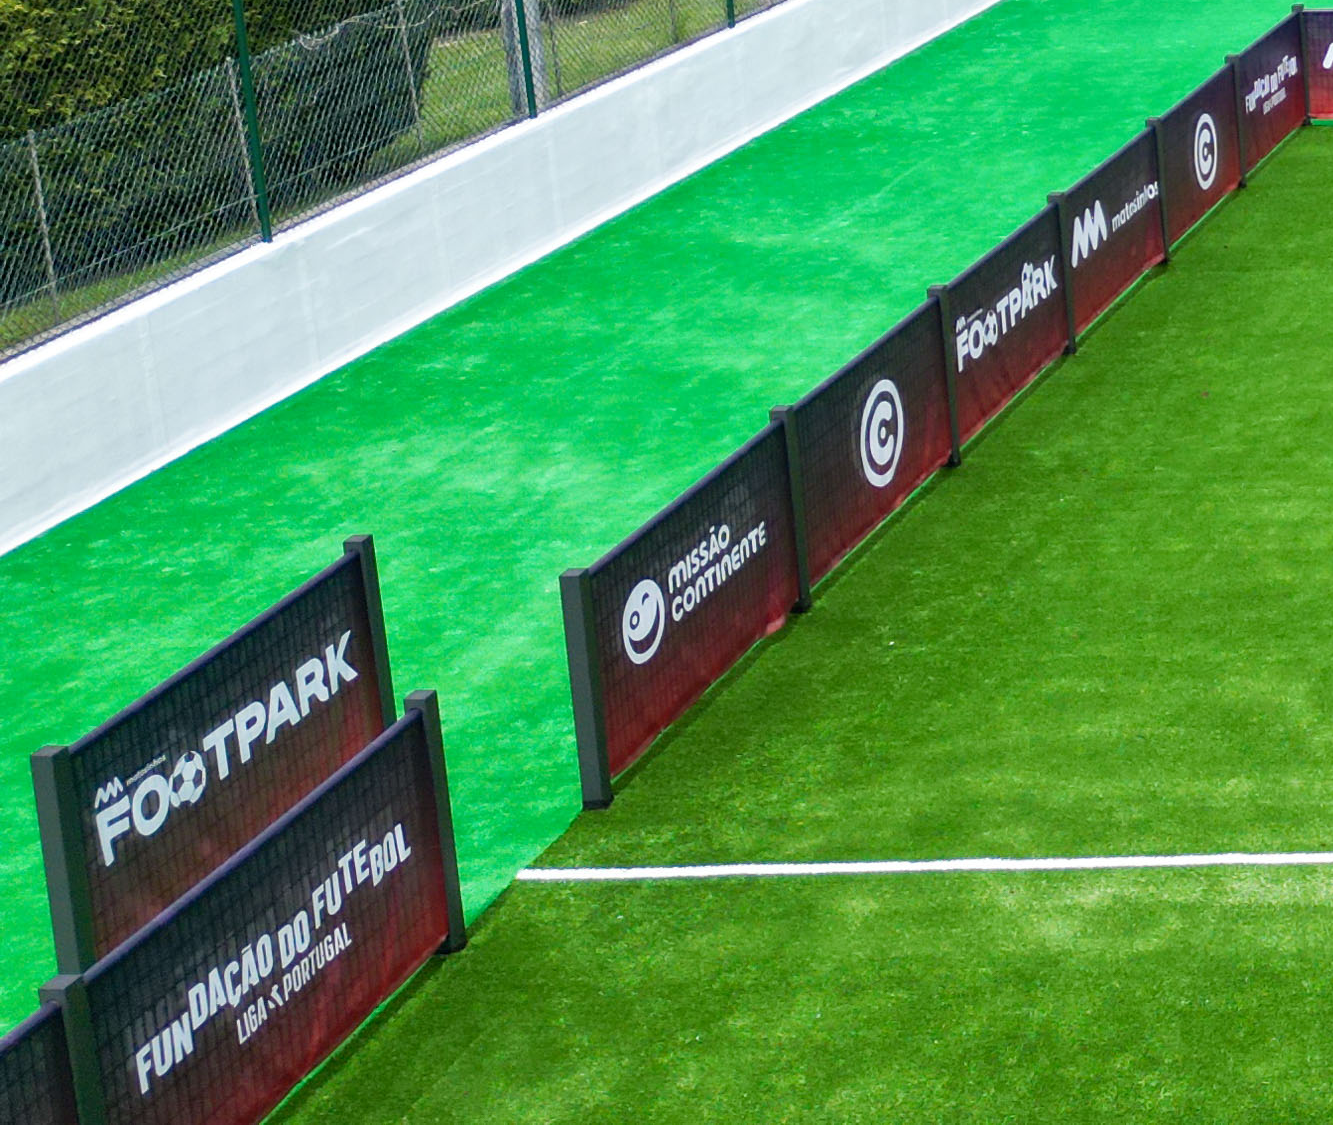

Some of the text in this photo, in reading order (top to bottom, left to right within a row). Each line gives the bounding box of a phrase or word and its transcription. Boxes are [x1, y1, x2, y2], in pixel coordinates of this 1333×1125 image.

[668, 524, 730, 594] MISSÃO
[672, 521, 766, 622] CONTINENTE
[135, 823, 411, 1095] FUNDAÇÃO DO FUTEBOL
[236, 922, 352, 1045] LIGA PORTUGAL
